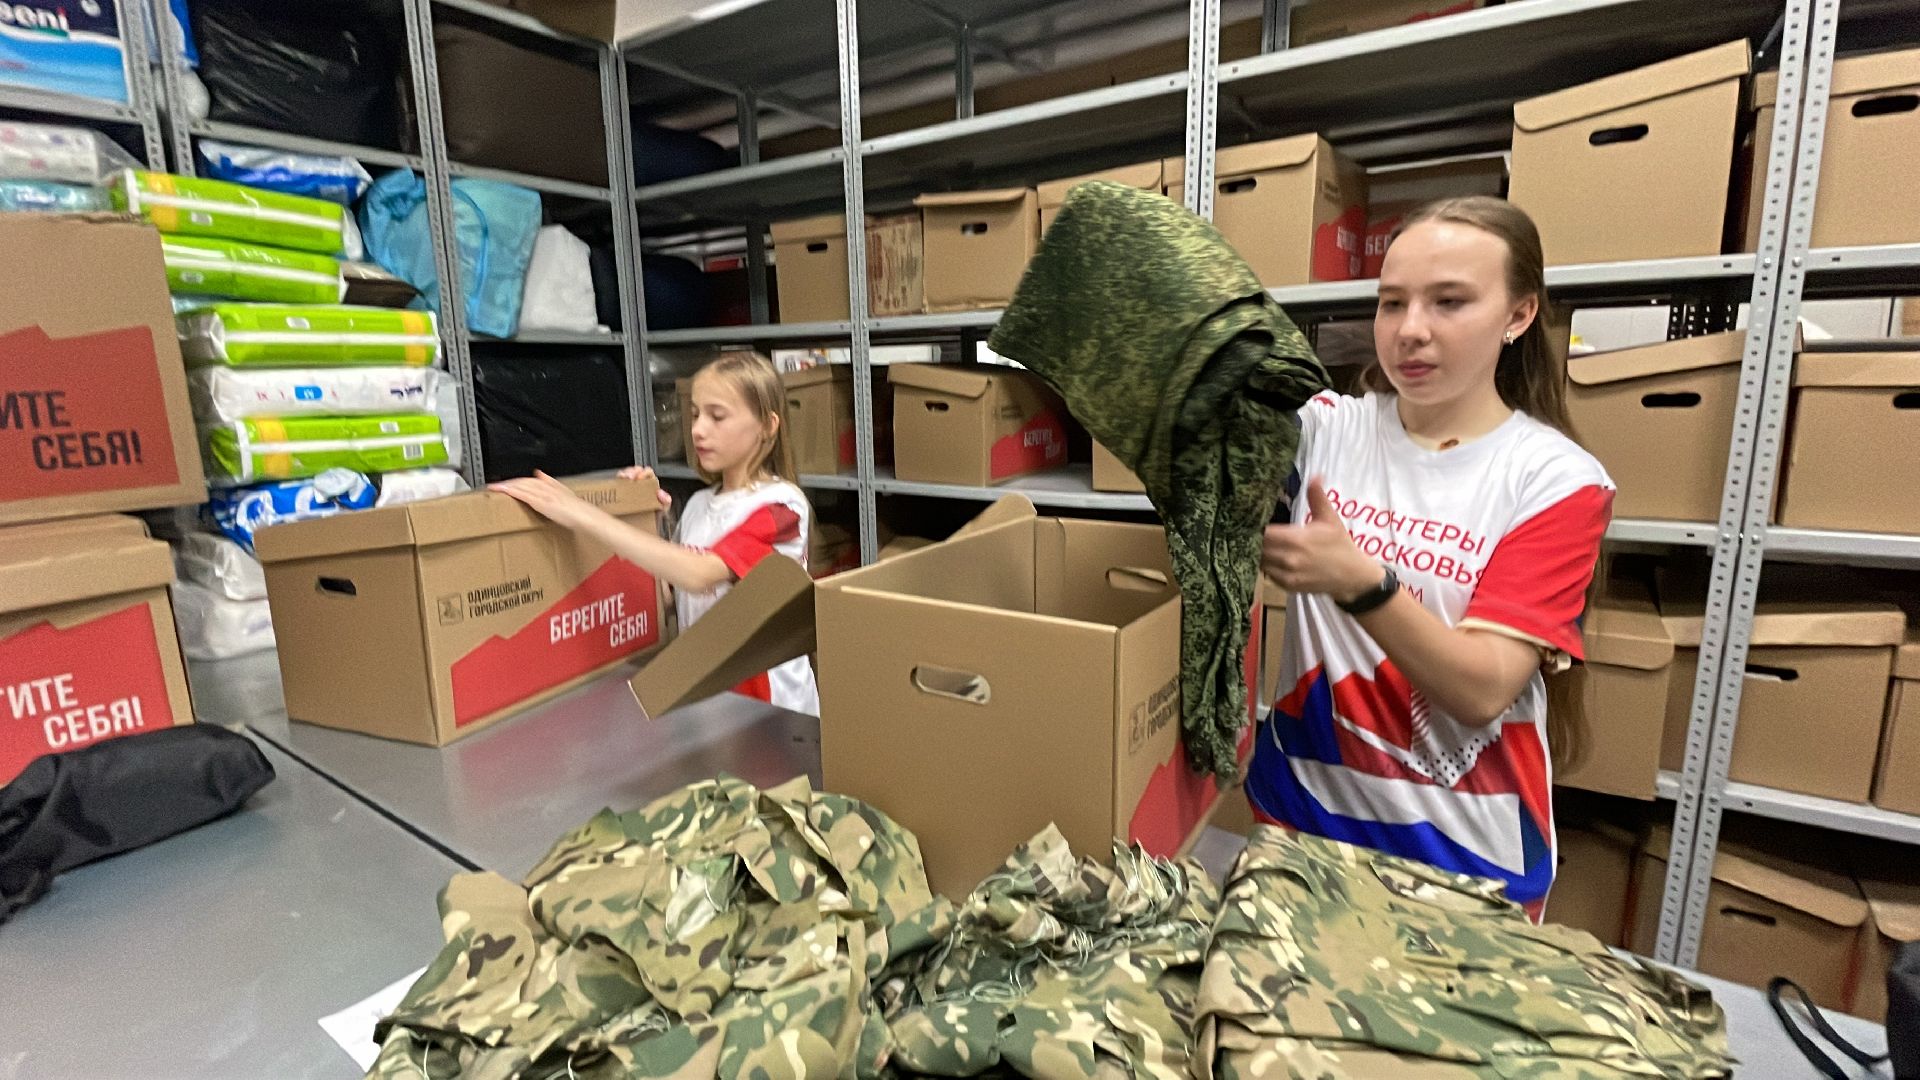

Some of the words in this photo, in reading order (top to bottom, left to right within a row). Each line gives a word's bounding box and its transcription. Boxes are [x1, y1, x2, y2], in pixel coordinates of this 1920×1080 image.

[32, 427, 143, 471] СЕБЯ!
[469, 593, 520, 619] ГОРОДСКОЙ
[520, 587, 544, 605] ОКРУГ
[550, 592, 625, 645] БЕРЕГИТЕ
[609, 609, 648, 648] СЕБЯ!
[43, 695, 144, 749] СЕБЯ!
